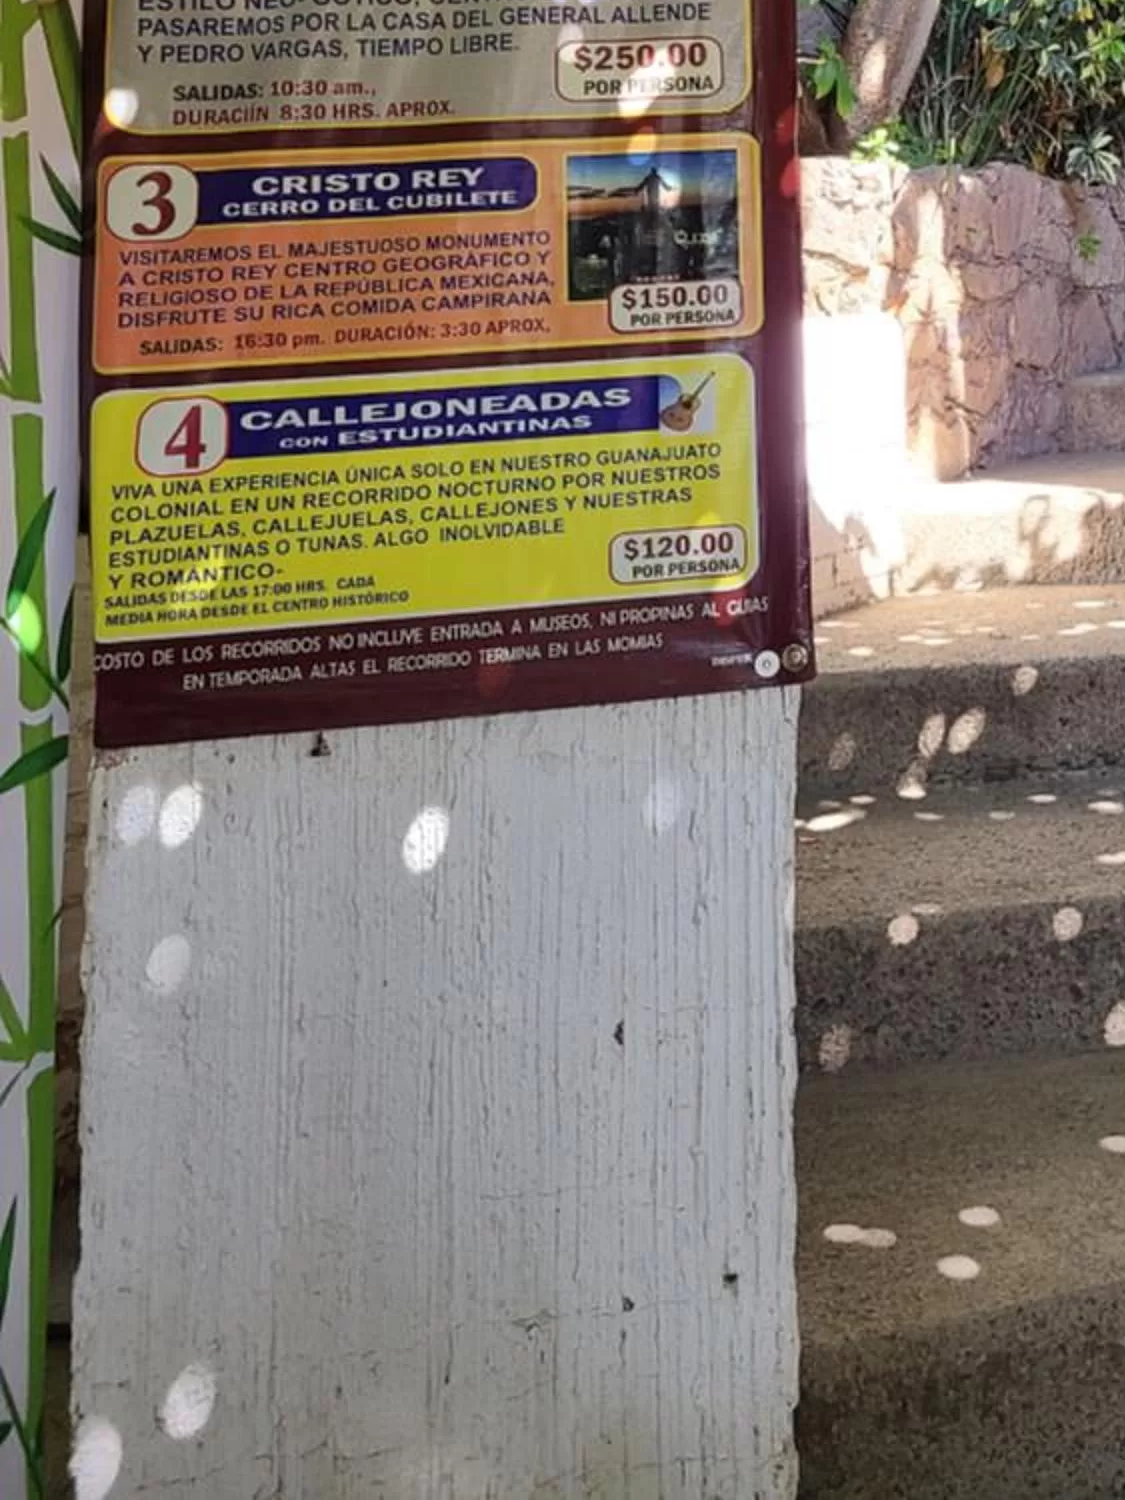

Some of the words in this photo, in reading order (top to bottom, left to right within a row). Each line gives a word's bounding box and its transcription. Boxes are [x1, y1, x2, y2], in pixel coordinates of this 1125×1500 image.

[138, 16, 284, 36] PASAREMOS
[291, 12, 339, 31] POR
[347, 14, 376, 30] LA
[383, 12, 446, 30] CASA
[453, 10, 494, 29] DEL
[500, 5, 605, 26] GENERAL
[611, 2, 712, 23] ALLENDE
[138, 46, 154, 62] Y
[161, 44, 243, 62] PEDRO
[251, 39, 348, 60] VARGAS,
[356, 37, 444, 57] TIEMPO
[574, 42, 707, 72] $250.00
[584, 80, 621, 95] POR
[253, 172, 400, 196] CRISTO
[412, 167, 484, 189] REY
[132, 171, 176, 236] 3
[223, 200, 319, 218] CERRO
[328, 198, 380, 213] DEL
[386, 190, 518, 210] CUBILETE
[119, 246, 251, 266] VISITAREMOS
[259, 244, 282, 259] EL
[288, 236, 420, 258] MAJESTUOSO
[426, 231, 551, 249] MONUMENTO
[118, 272, 134, 286] A
[142, 265, 223, 285] CRISTO
[231, 264, 276, 281] REY
[284, 259, 376, 279] CENTRO
[538, 252, 551, 266] Y
[623, 284, 728, 310] $150.00
[630, 313, 661, 326] POR
[666, 309, 736, 325] PERSONA
[240, 388, 631, 430] CALLEJONEADAS
[164, 405, 206, 468] 4
[279, 436, 328, 449] CON
[338, 415, 592, 445] ESTUDIANTINAS
[111, 485, 156, 500] VIVA
[162, 481, 203, 497] UNA
[210, 470, 339, 492] EXPERIENCIA
[346, 464, 405, 483] ÚNICA
[412, 460, 465, 479] SOLO
[470, 459, 495, 475] EN
[502, 452, 591, 471] NUESTRO
[597, 444, 721, 467] GUANAJUATO
[111, 501, 223, 524] COLONIAL
[231, 499, 259, 513] EN
[267, 496, 295, 512] UN
[303, 484, 431, 509] RECORRIDO
[438, 477, 556, 499] NOCTURNO
[563, 473, 605, 490] POR
[612, 464, 720, 485] NUESTROS
[625, 532, 734, 561] $120.00
[632, 563, 663, 579] POR
[668, 556, 740, 576] PERSONA
[183, 674, 204, 690] EN
[210, 667, 301, 689] TEMPORADA
[311, 661, 355, 679] ALTAS
[363, 660, 380, 674] EL
[387, 649, 471, 673] RECORRIDO
[480, 645, 541, 665] TERMINA
[548, 643, 568, 657] EN
[576, 639, 600, 656] LAS
